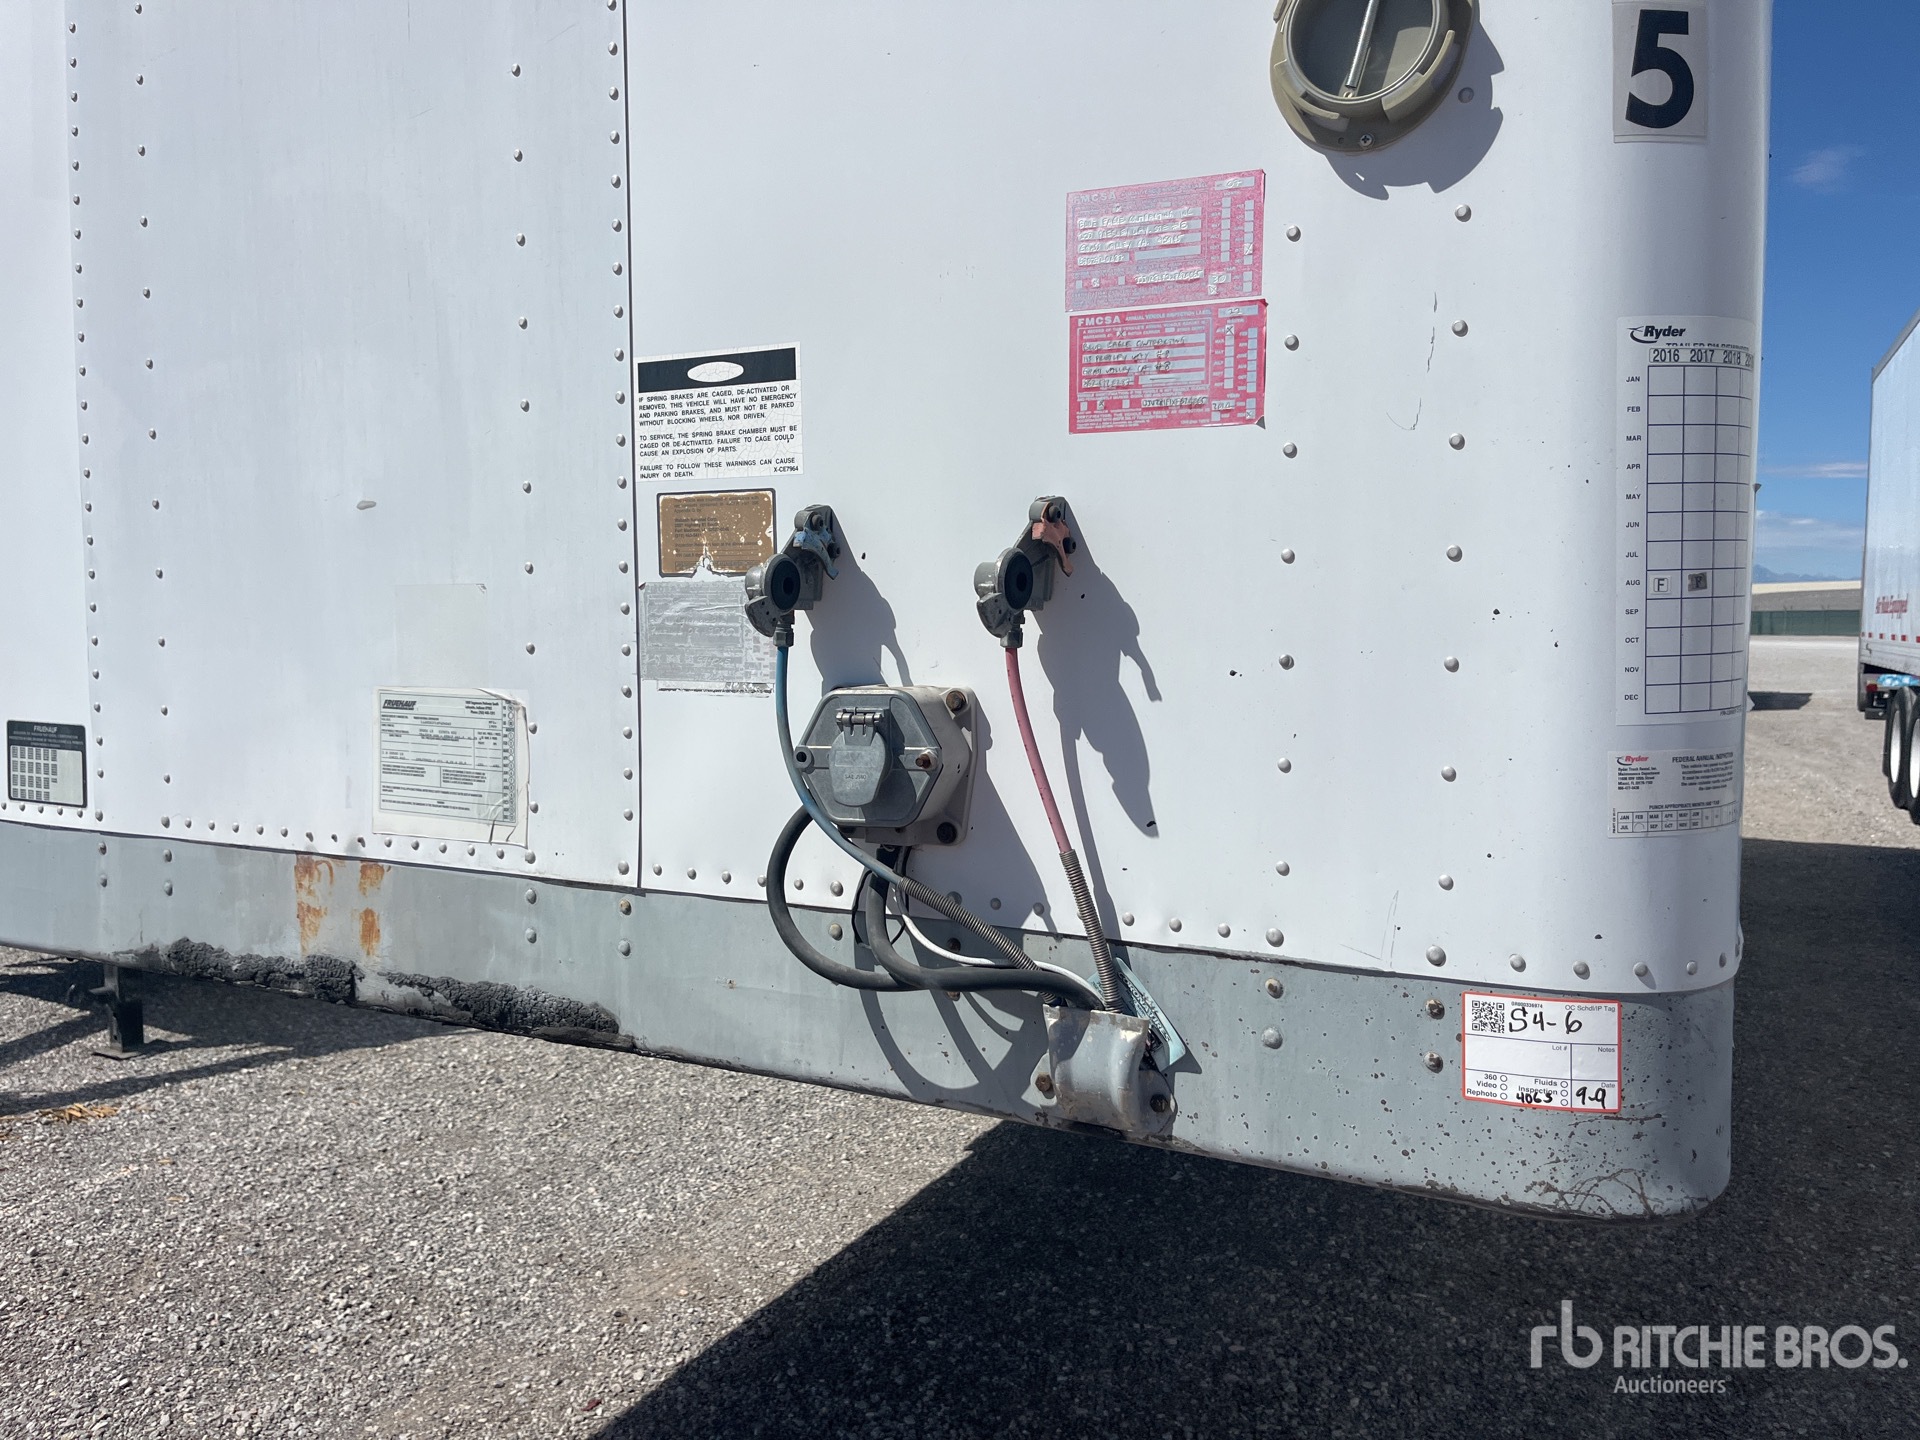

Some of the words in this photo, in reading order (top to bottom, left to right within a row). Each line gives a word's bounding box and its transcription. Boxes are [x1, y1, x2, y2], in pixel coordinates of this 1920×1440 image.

[1625, 9, 1694, 129] 5
[1078, 315, 1121, 326] FMCSA
[1644, 325, 1686, 339] Ryder
[1653, 350, 1680, 362] 2016
[1690, 350, 1714, 362] 2017
[1723, 350, 1740, 365] 2018
[737, 385, 778, 395] DE-ACTIVATED
[761, 393, 797, 402] EMERGENCY
[1657, 578, 1665, 591] F
[383, 700, 416, 708] FRUEHAUF
[1467, 1089, 1497, 1099] Rephoto
[1518, 1086, 1558, 1095] Inspection
